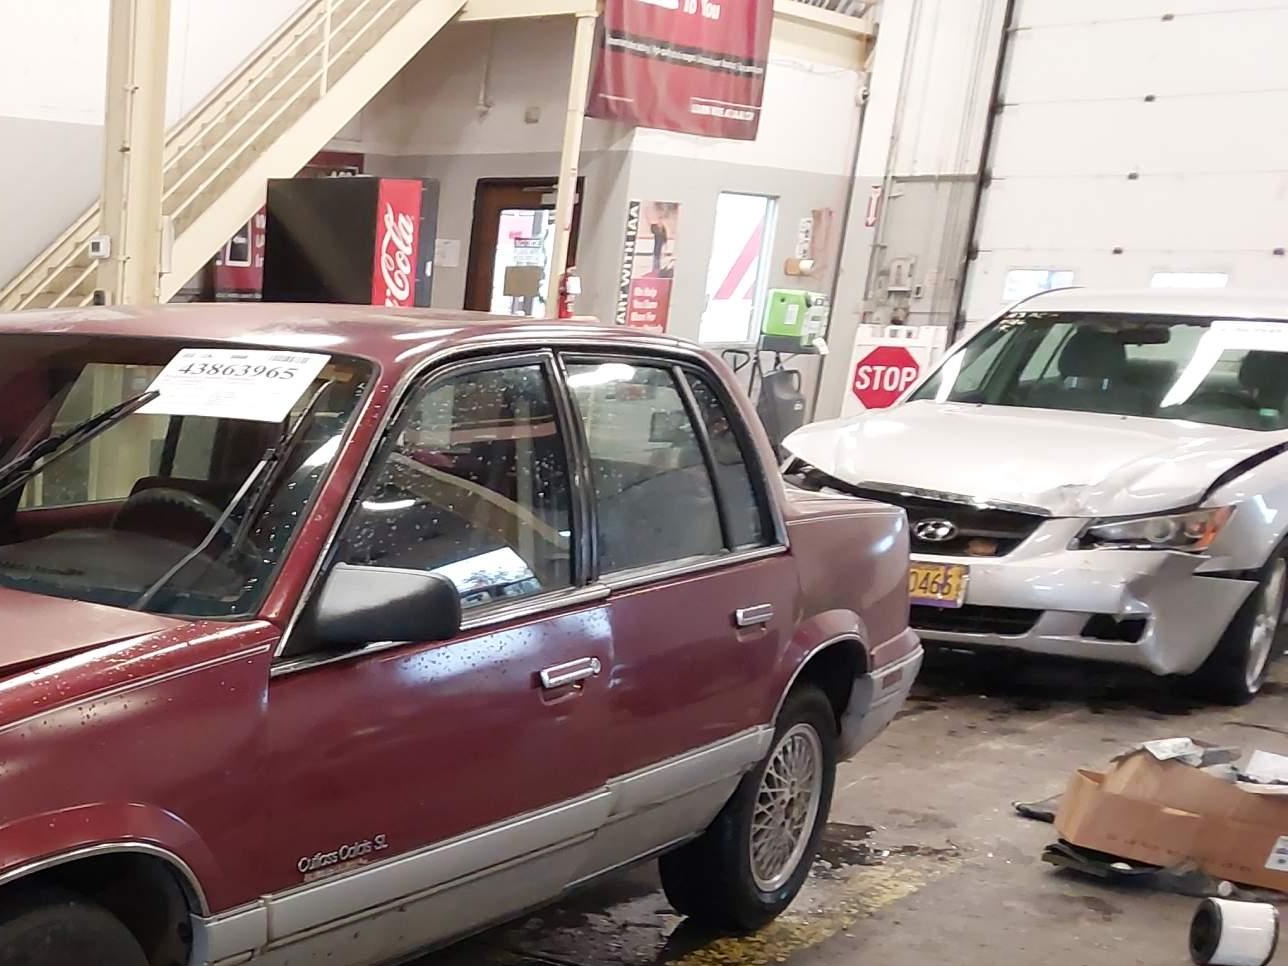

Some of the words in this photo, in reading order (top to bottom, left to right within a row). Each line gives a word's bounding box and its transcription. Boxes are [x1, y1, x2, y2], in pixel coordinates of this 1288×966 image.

[626, 205, 639, 237] IAA
[621, 241, 634, 287] WITH
[178, 362, 299, 380] 43863965
[855, 364, 917, 392] STOP
